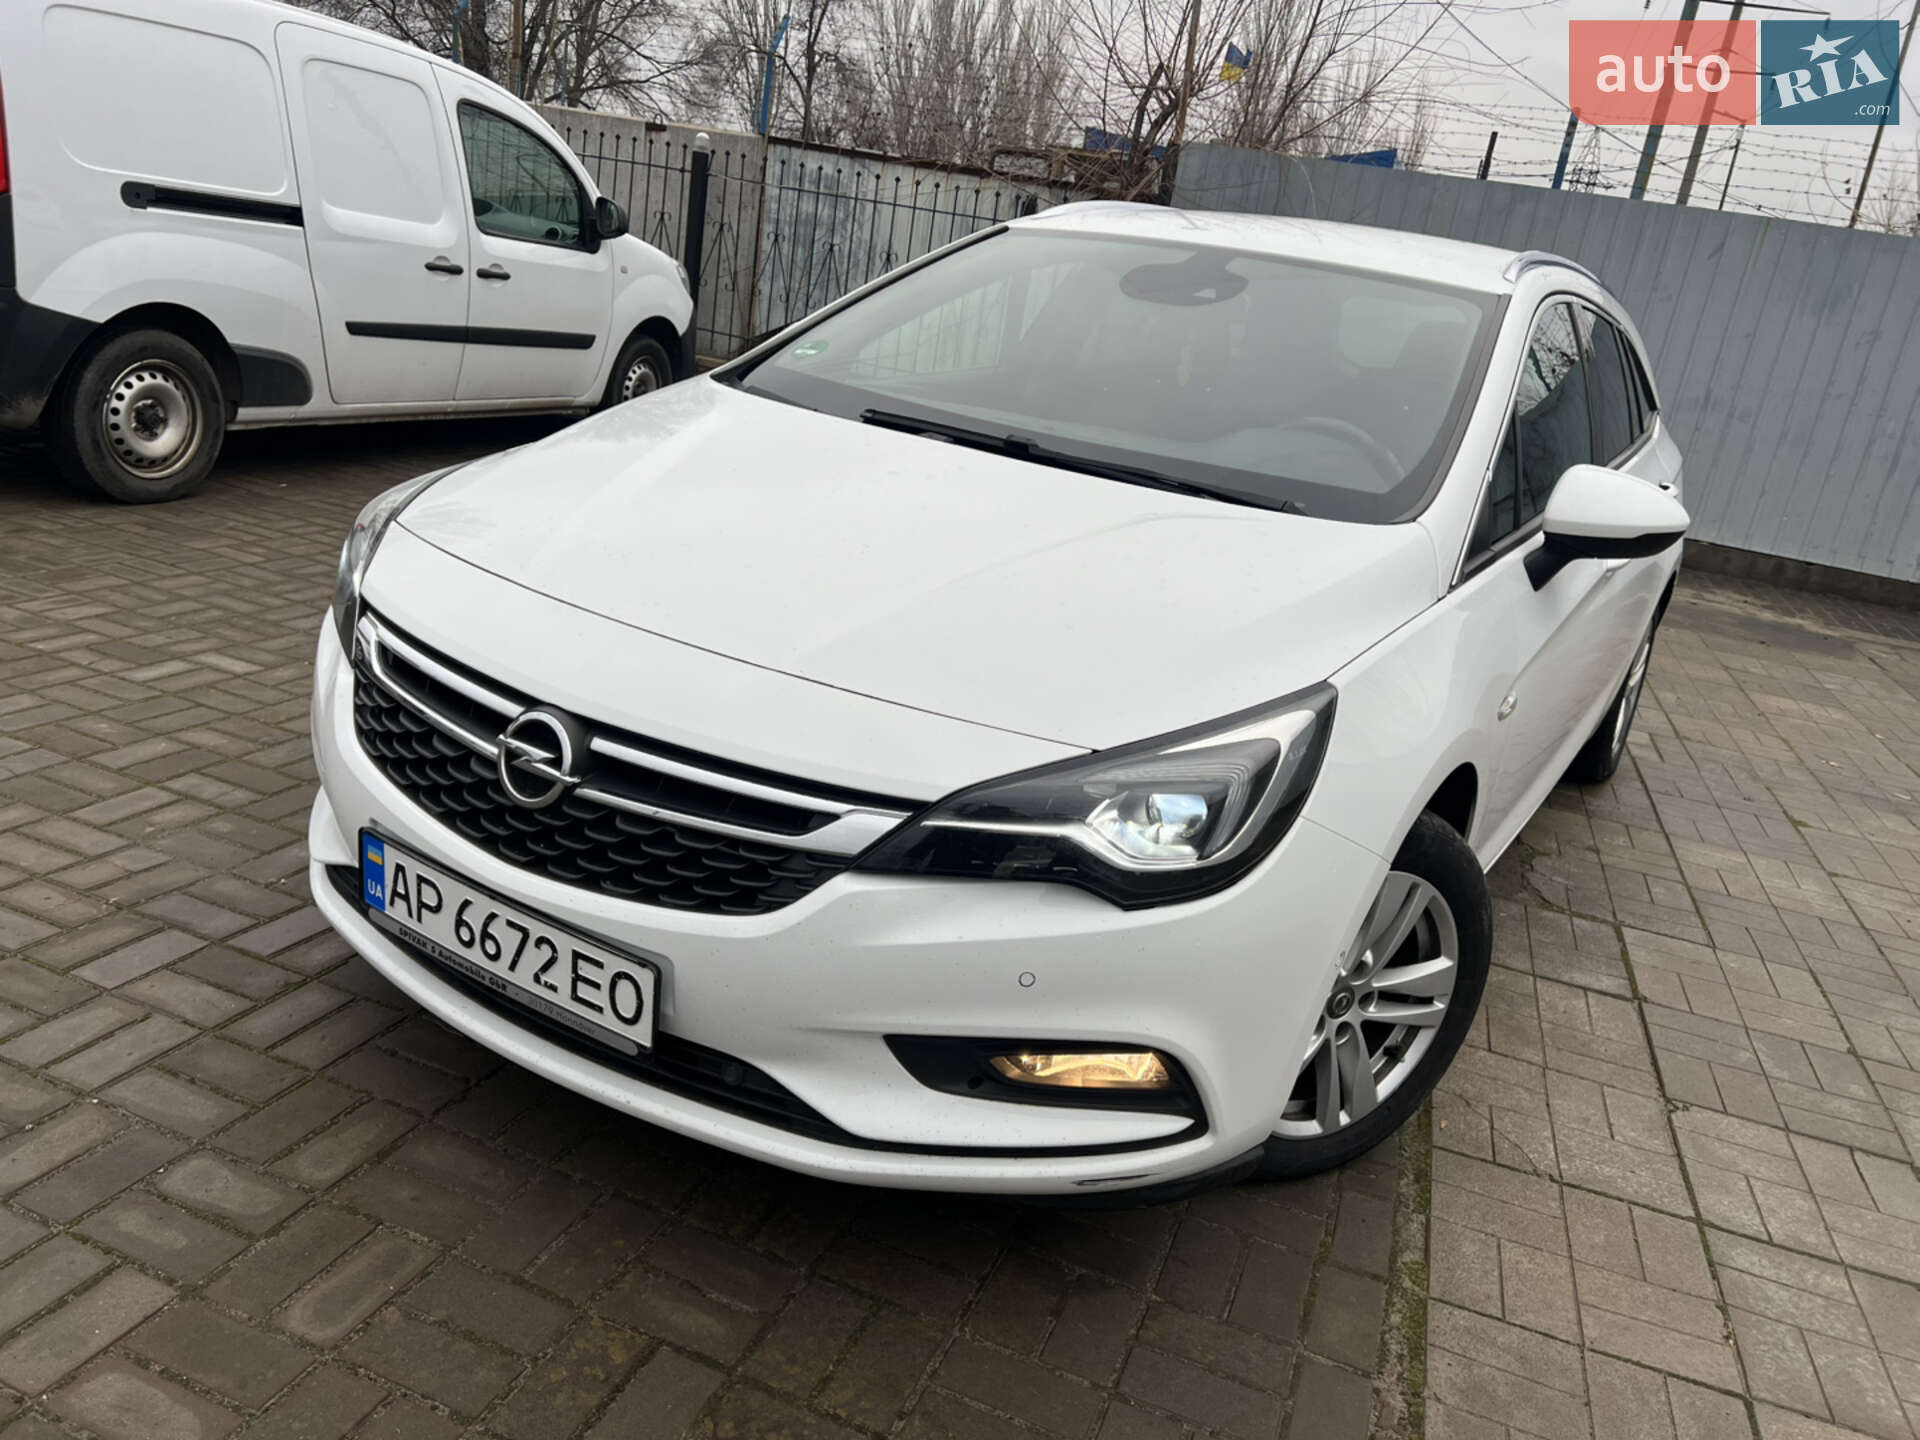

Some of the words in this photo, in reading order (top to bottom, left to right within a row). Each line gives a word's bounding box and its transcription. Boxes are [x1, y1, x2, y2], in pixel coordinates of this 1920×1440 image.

[367, 878, 384, 900] UA
[389, 862, 443, 923] AP
[454, 898, 559, 994] 6672
[570, 948, 644, 1026] EO
